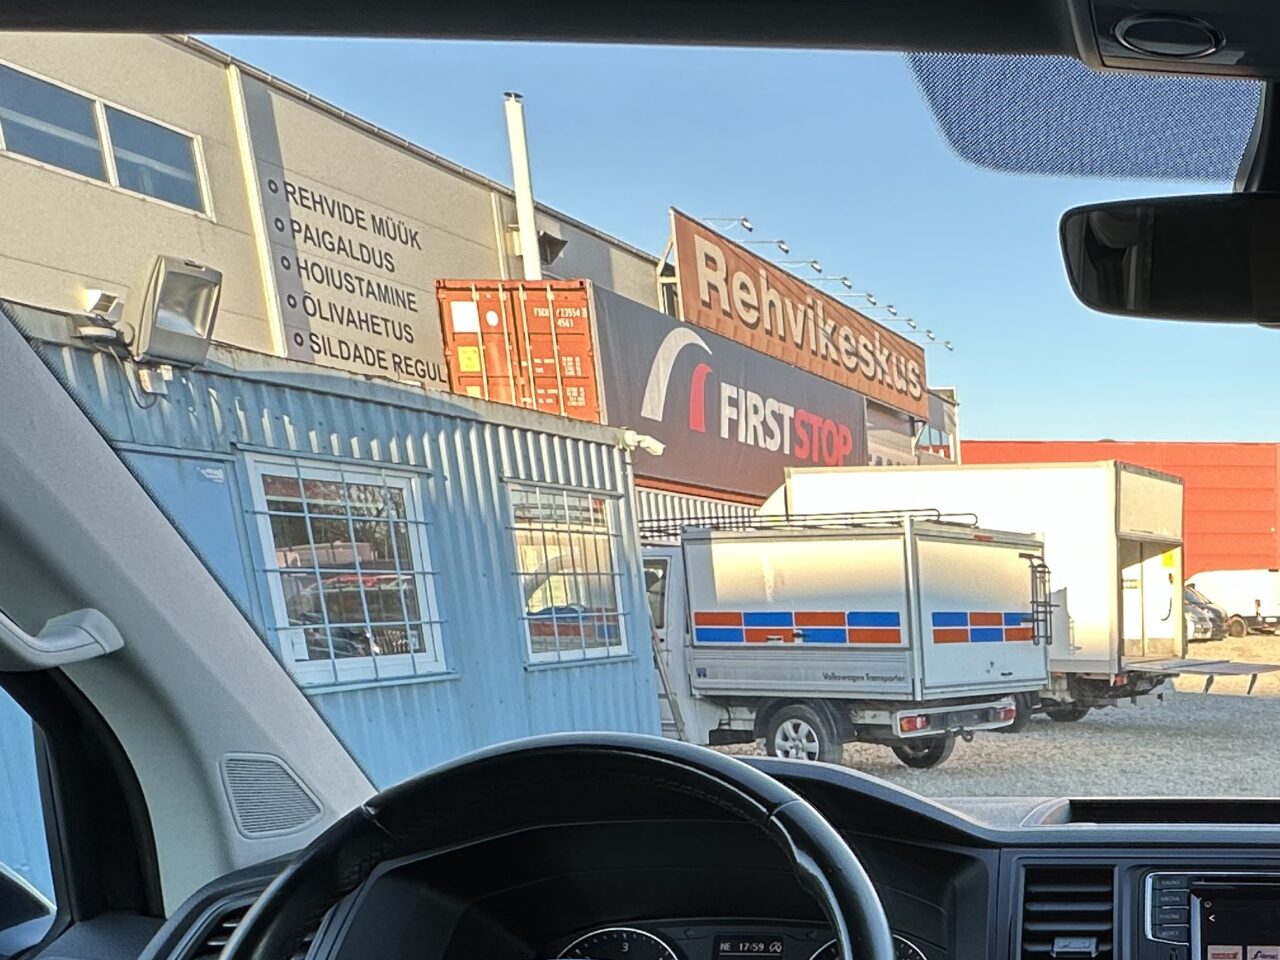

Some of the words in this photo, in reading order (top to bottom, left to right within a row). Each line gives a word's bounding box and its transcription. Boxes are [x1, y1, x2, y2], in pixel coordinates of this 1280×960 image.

[284, 181, 367, 230] REHVIDE
[371, 213, 422, 250] MÜÜK
[290, 218, 395, 272] PAIGALDUS
[297, 256, 418, 312] HOIUSTAMINE
[302, 291, 414, 344] ÕLIVAHETUS
[693, 234, 923, 401] Rehvikeskus
[309, 332, 388, 371] SILDADE
[822, 672, 865, 682] Volkswagen
[865, 673, 906, 683] Transporter
[621, 942, 629, 953] 3
[739, 942, 764, 951] 17:59
